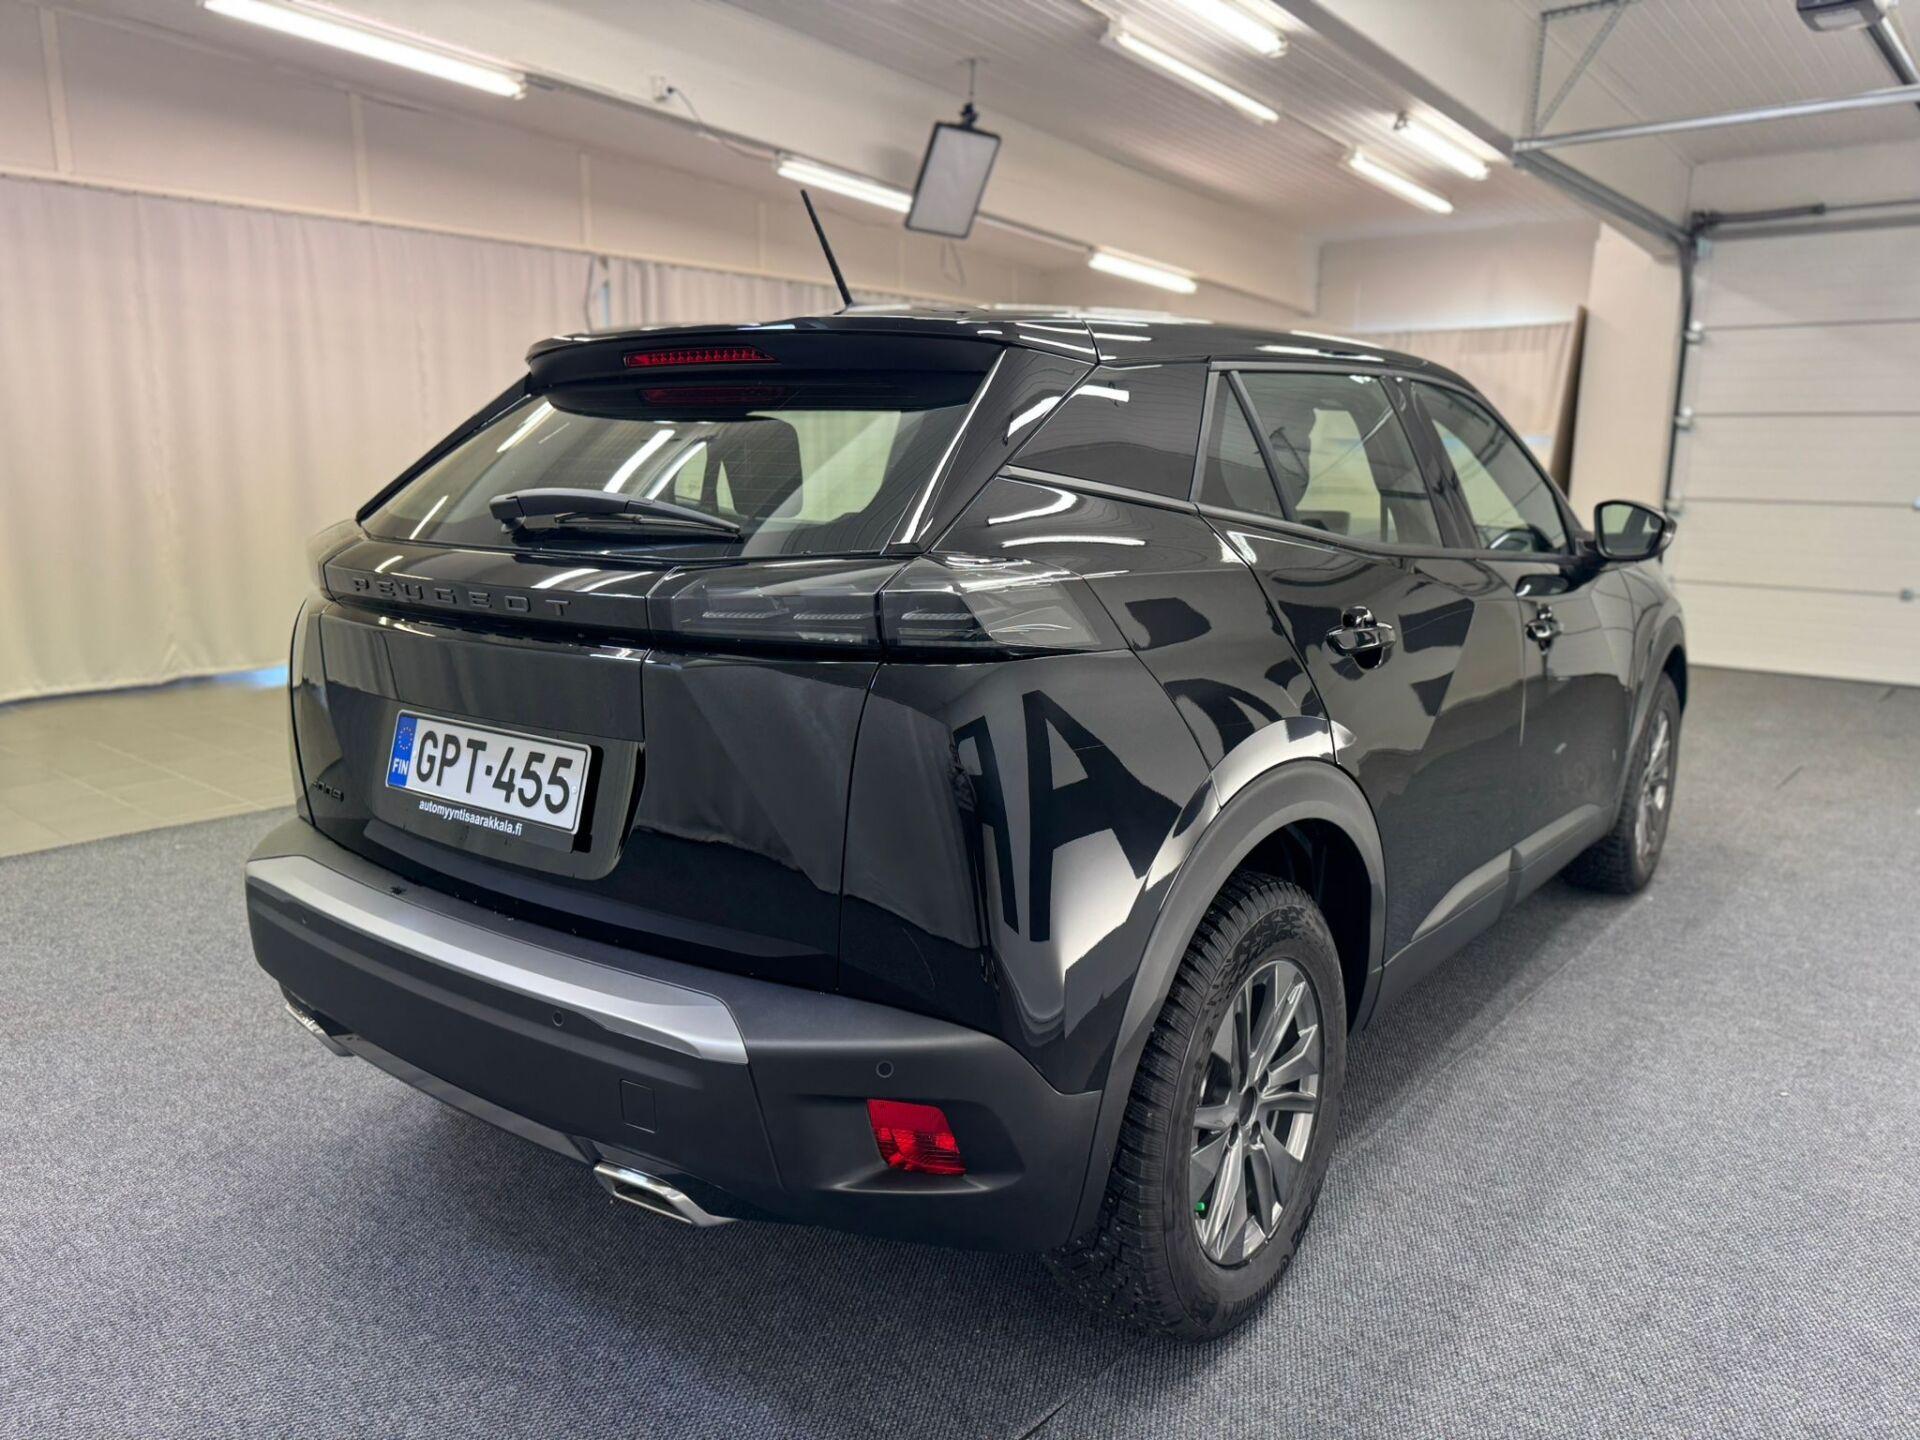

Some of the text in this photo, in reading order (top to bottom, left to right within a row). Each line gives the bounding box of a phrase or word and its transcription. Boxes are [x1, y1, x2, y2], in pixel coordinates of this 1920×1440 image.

[353, 577, 571, 616] PEUGEOT
[392, 758, 410, 776] FIN
[419, 799, 522, 836] automyyntisaarakkala.fi
